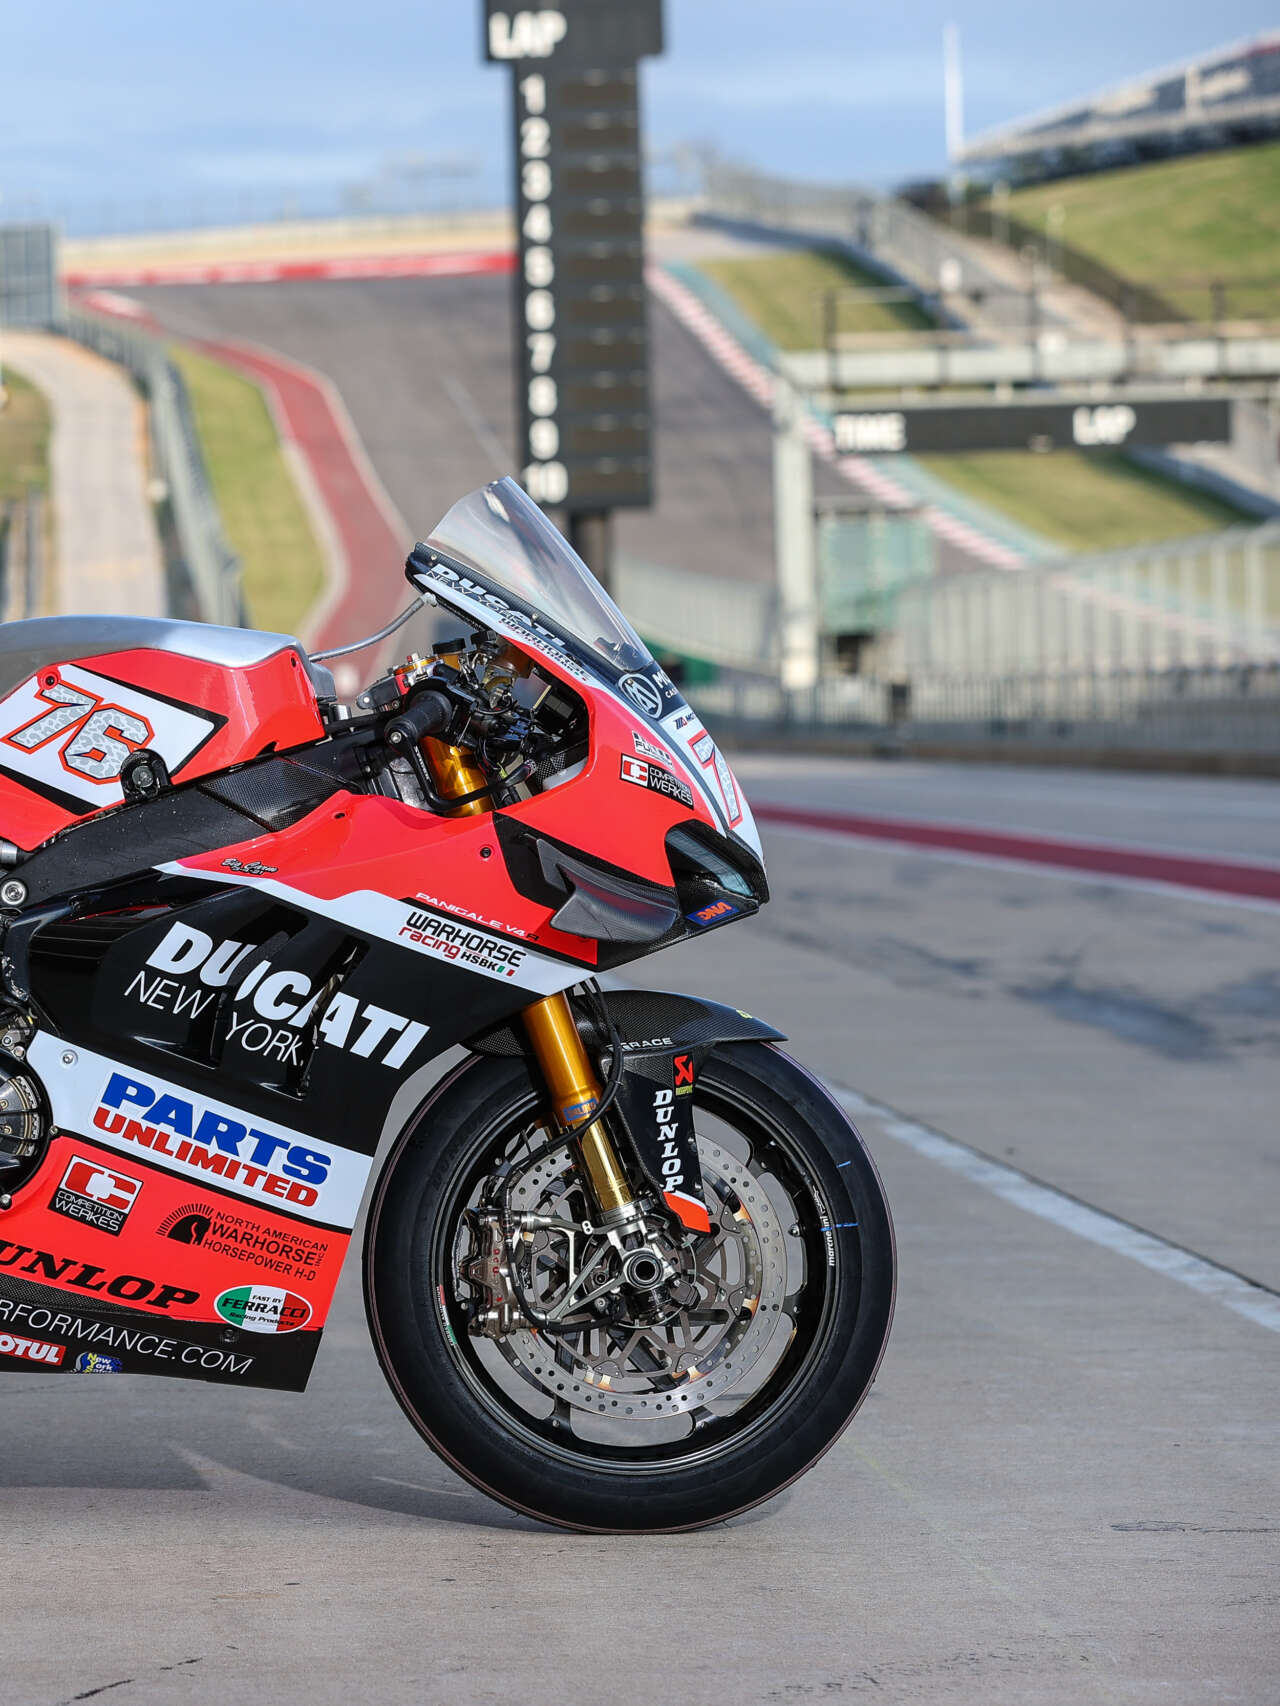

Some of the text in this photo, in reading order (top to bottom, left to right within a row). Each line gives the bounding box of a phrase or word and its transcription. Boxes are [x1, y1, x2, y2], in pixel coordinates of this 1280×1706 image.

[489, 10, 567, 59] LAP
[521, 73, 546, 115] 1
[521, 117, 550, 158] 2
[521, 159, 552, 202] 3
[522, 203, 552, 244] 4
[526, 332, 556, 374] 7
[521, 461, 569, 504] 10
[430, 563, 566, 647] DUCATI
[0, 679, 156, 785] 76
[650, 775, 694, 806] WERKES
[415, 892, 504, 929] PANIGALE
[398, 926, 499, 972] racing HSBK
[406, 911, 527, 968] WARHORSE
[145, 921, 431, 1070] DUCATI
[124, 970, 304, 1067] NEW YORK
[100, 1072, 332, 1186] PARTS
[652, 1089, 684, 1193] DUNLOP
[93, 1106, 319, 1208] UNLIMITED
[55, 1197, 120, 1232] WERKES
[57, 1190, 124, 1221] COMPETITION
[211, 1221, 318, 1267] WARHORSE
[215, 1211, 329, 1252] NORTH AMERICAN
[203, 1238, 317, 1282] HORSEPOWER H-D
[221, 1298, 307, 1319] FERRACCI
[252, 1295, 270, 1303] FAST
